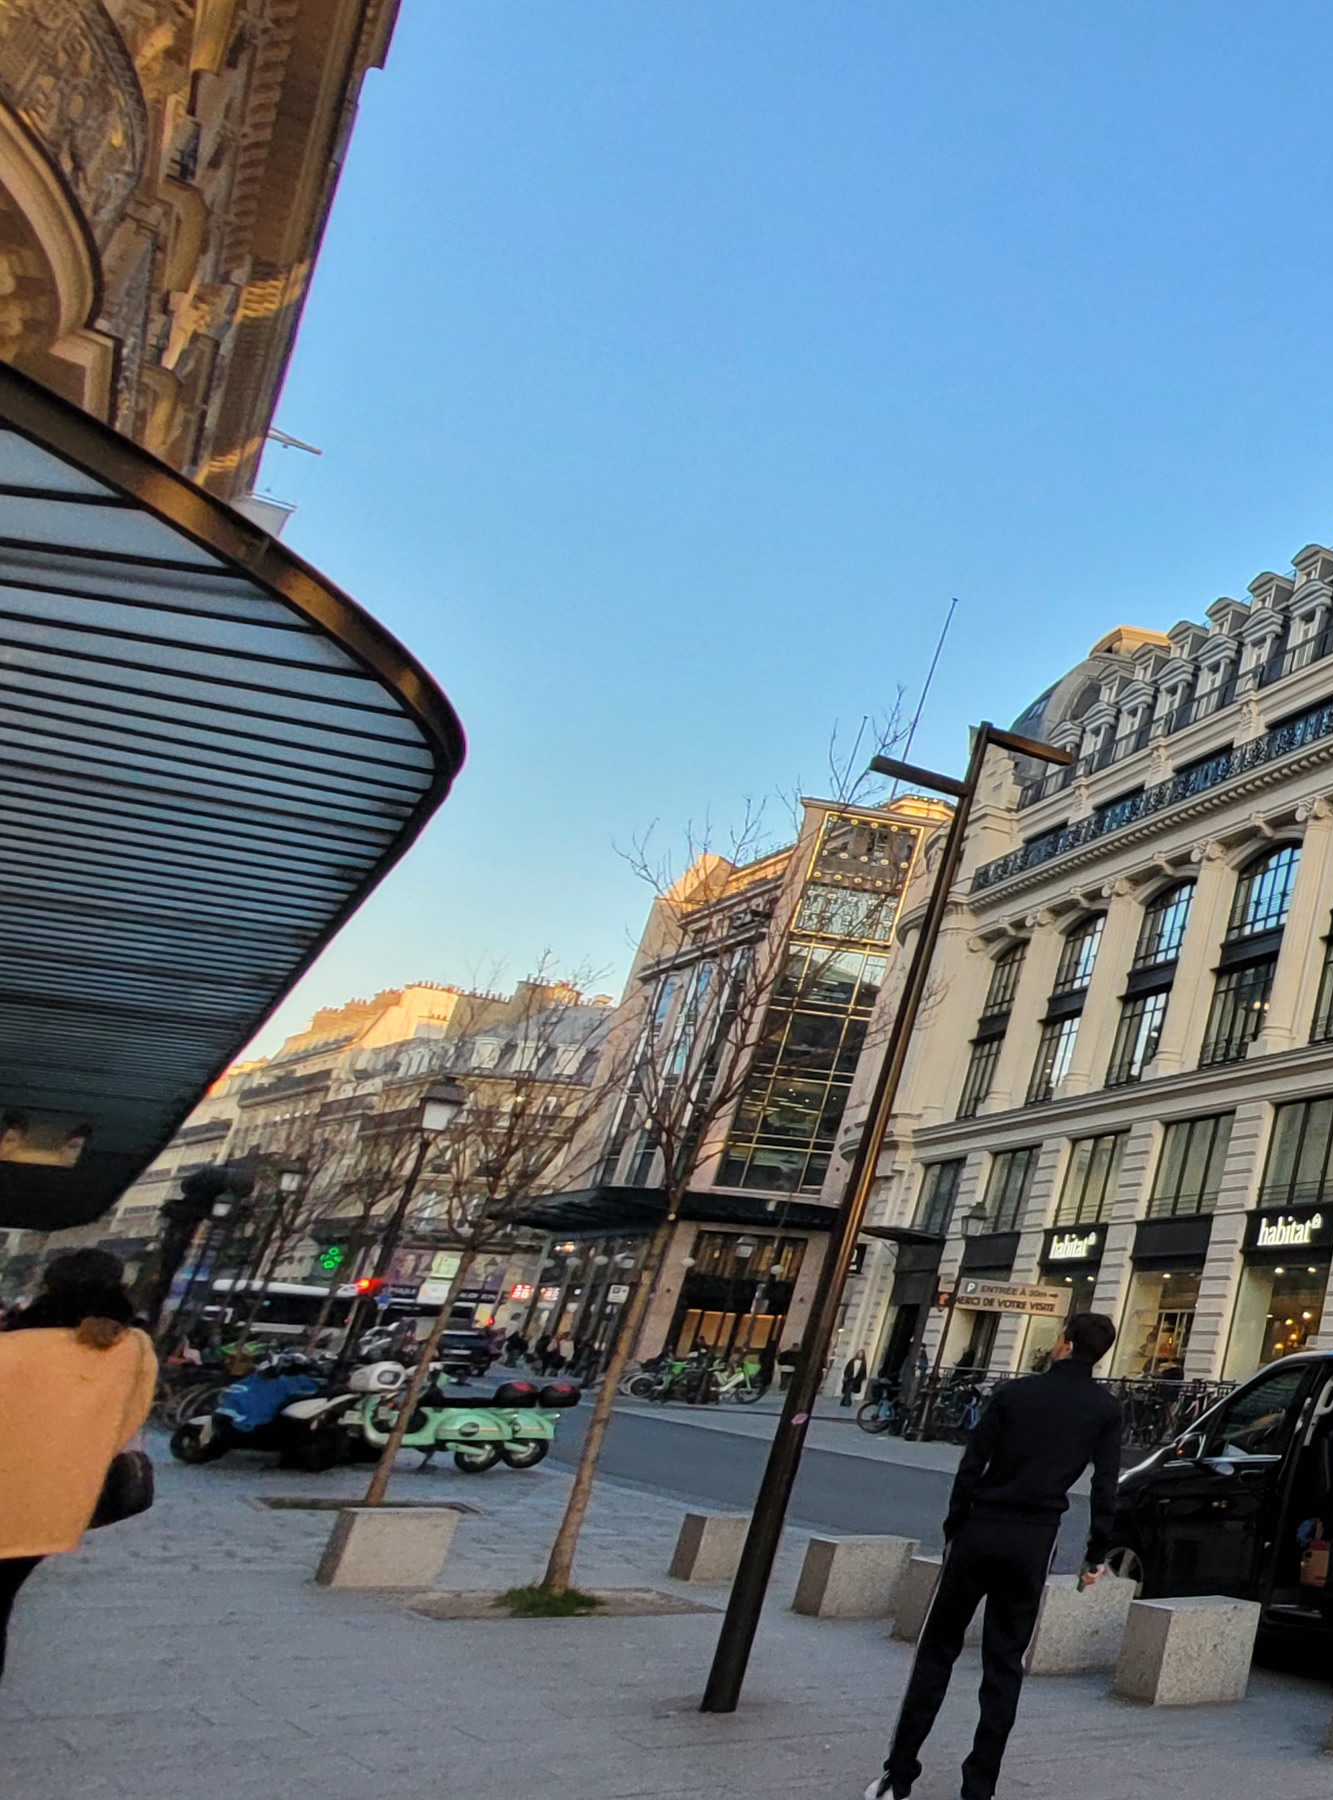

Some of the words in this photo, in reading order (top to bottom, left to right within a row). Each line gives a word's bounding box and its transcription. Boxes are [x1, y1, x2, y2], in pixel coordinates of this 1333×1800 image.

[1257, 1215, 1312, 1247] habitat
[1049, 1234, 1088, 1260] habitat
[982, 1297, 996, 1307] DE
[997, 1298, 1028, 1310] VOTRE
[1029, 1301, 1056, 1313] VISITE
